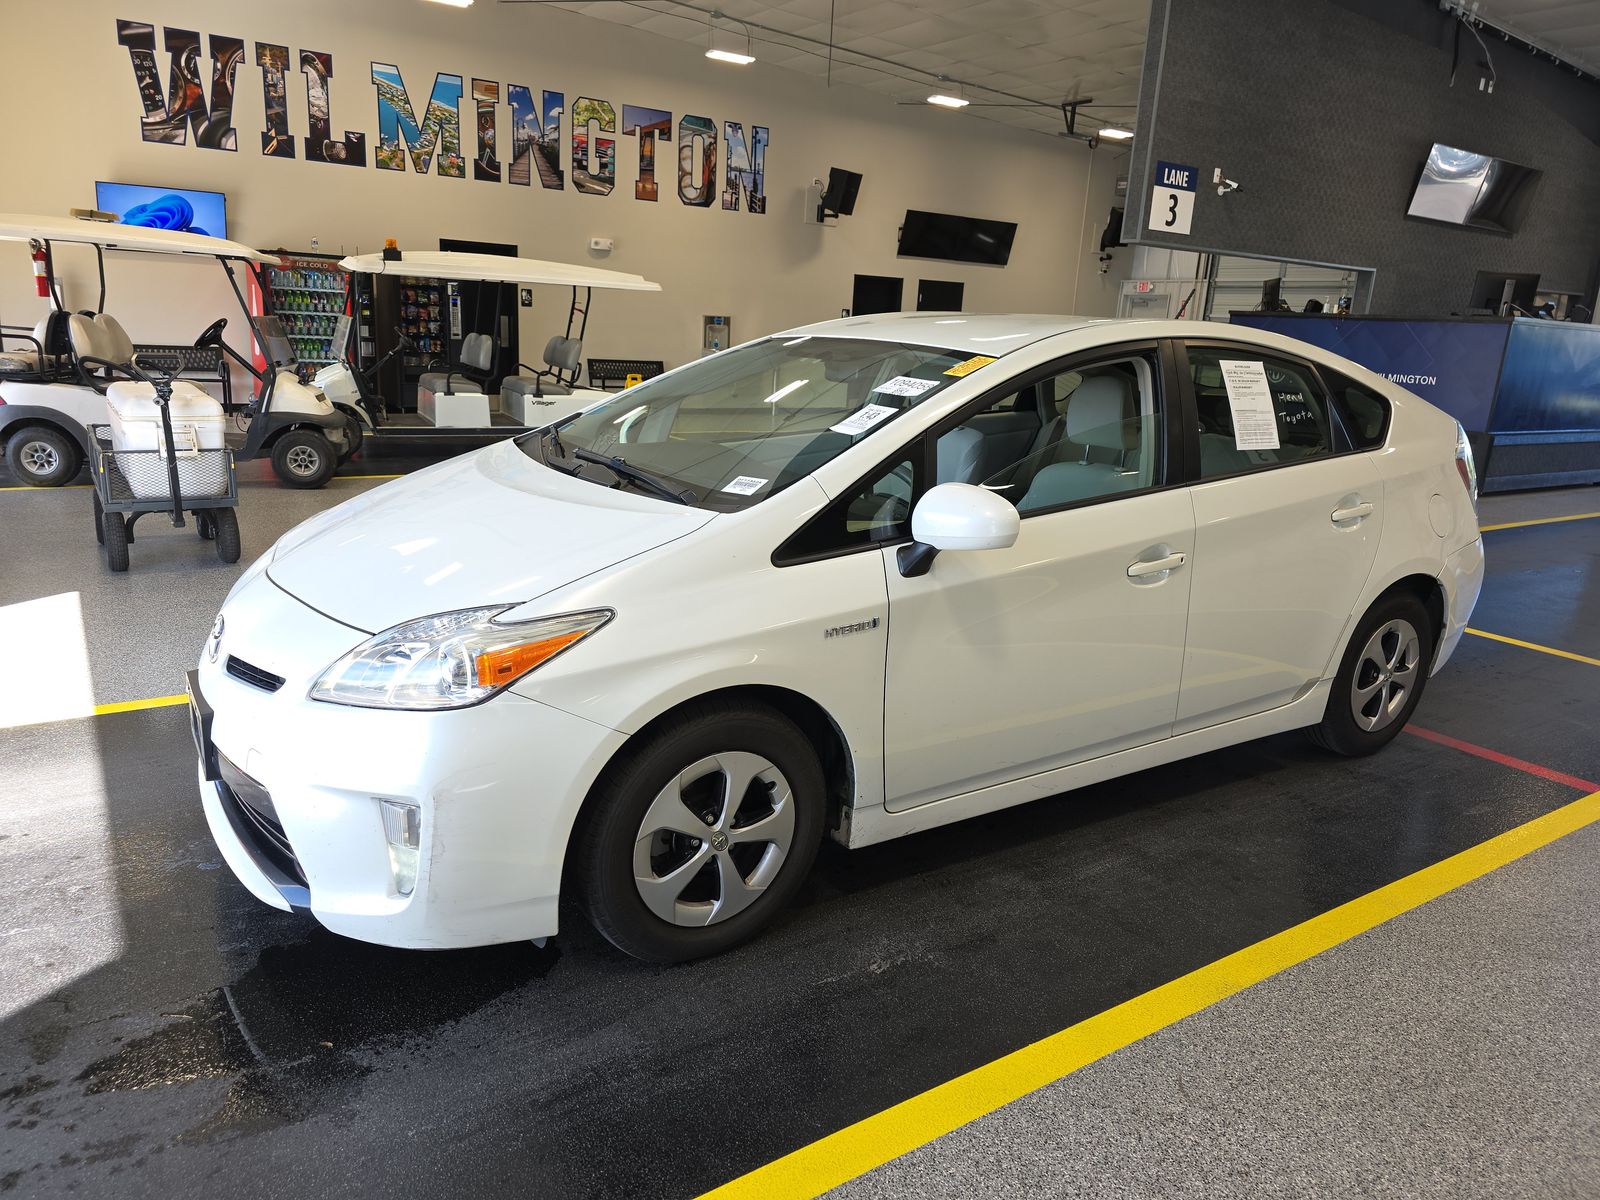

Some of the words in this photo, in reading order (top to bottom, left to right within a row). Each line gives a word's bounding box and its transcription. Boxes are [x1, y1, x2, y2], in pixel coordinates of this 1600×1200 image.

[116, 19, 769, 214] WILMINGTON
[1163, 167, 1189, 187] LANE
[1165, 193, 1179, 227] 3
[1279, 410, 1314, 424] Toyota
[824, 620, 871, 638] HYBRID
